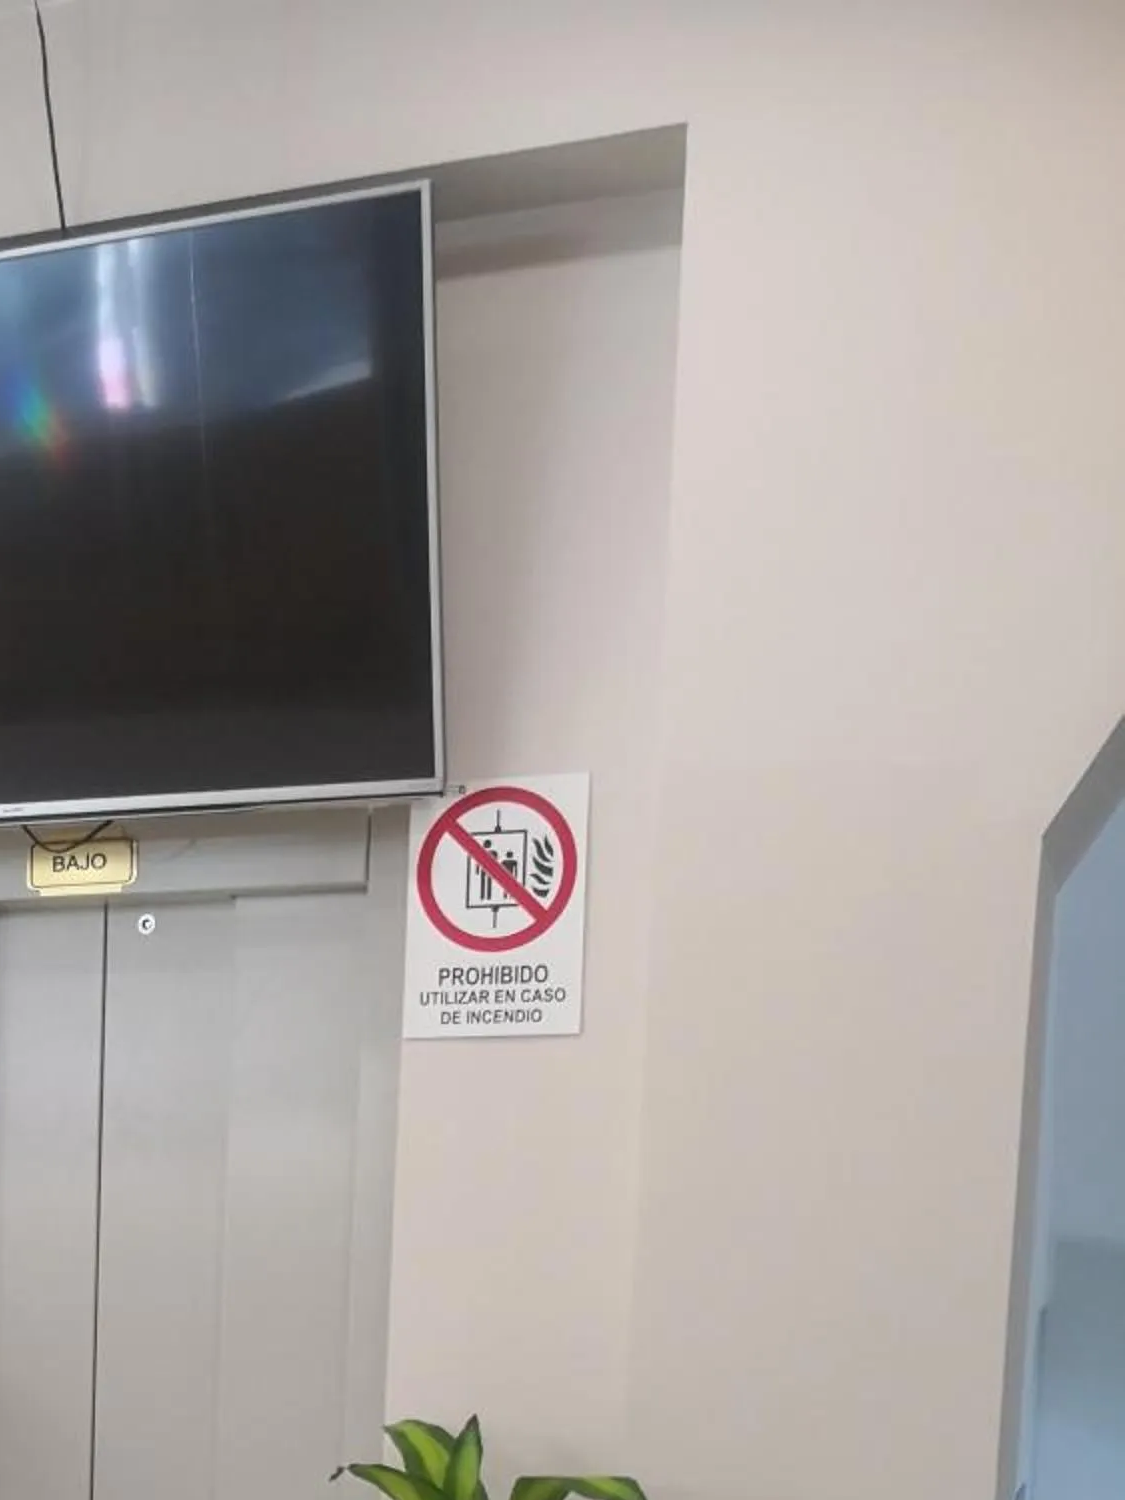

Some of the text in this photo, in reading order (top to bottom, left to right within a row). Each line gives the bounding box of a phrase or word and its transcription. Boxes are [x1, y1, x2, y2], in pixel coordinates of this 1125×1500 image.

[52, 852, 108, 873] BAJO
[438, 964, 550, 987] PROHIBIDO
[419, 987, 566, 1006] UTILIZAR EN CASO
[440, 1008, 543, 1025] DE INCENDIO
